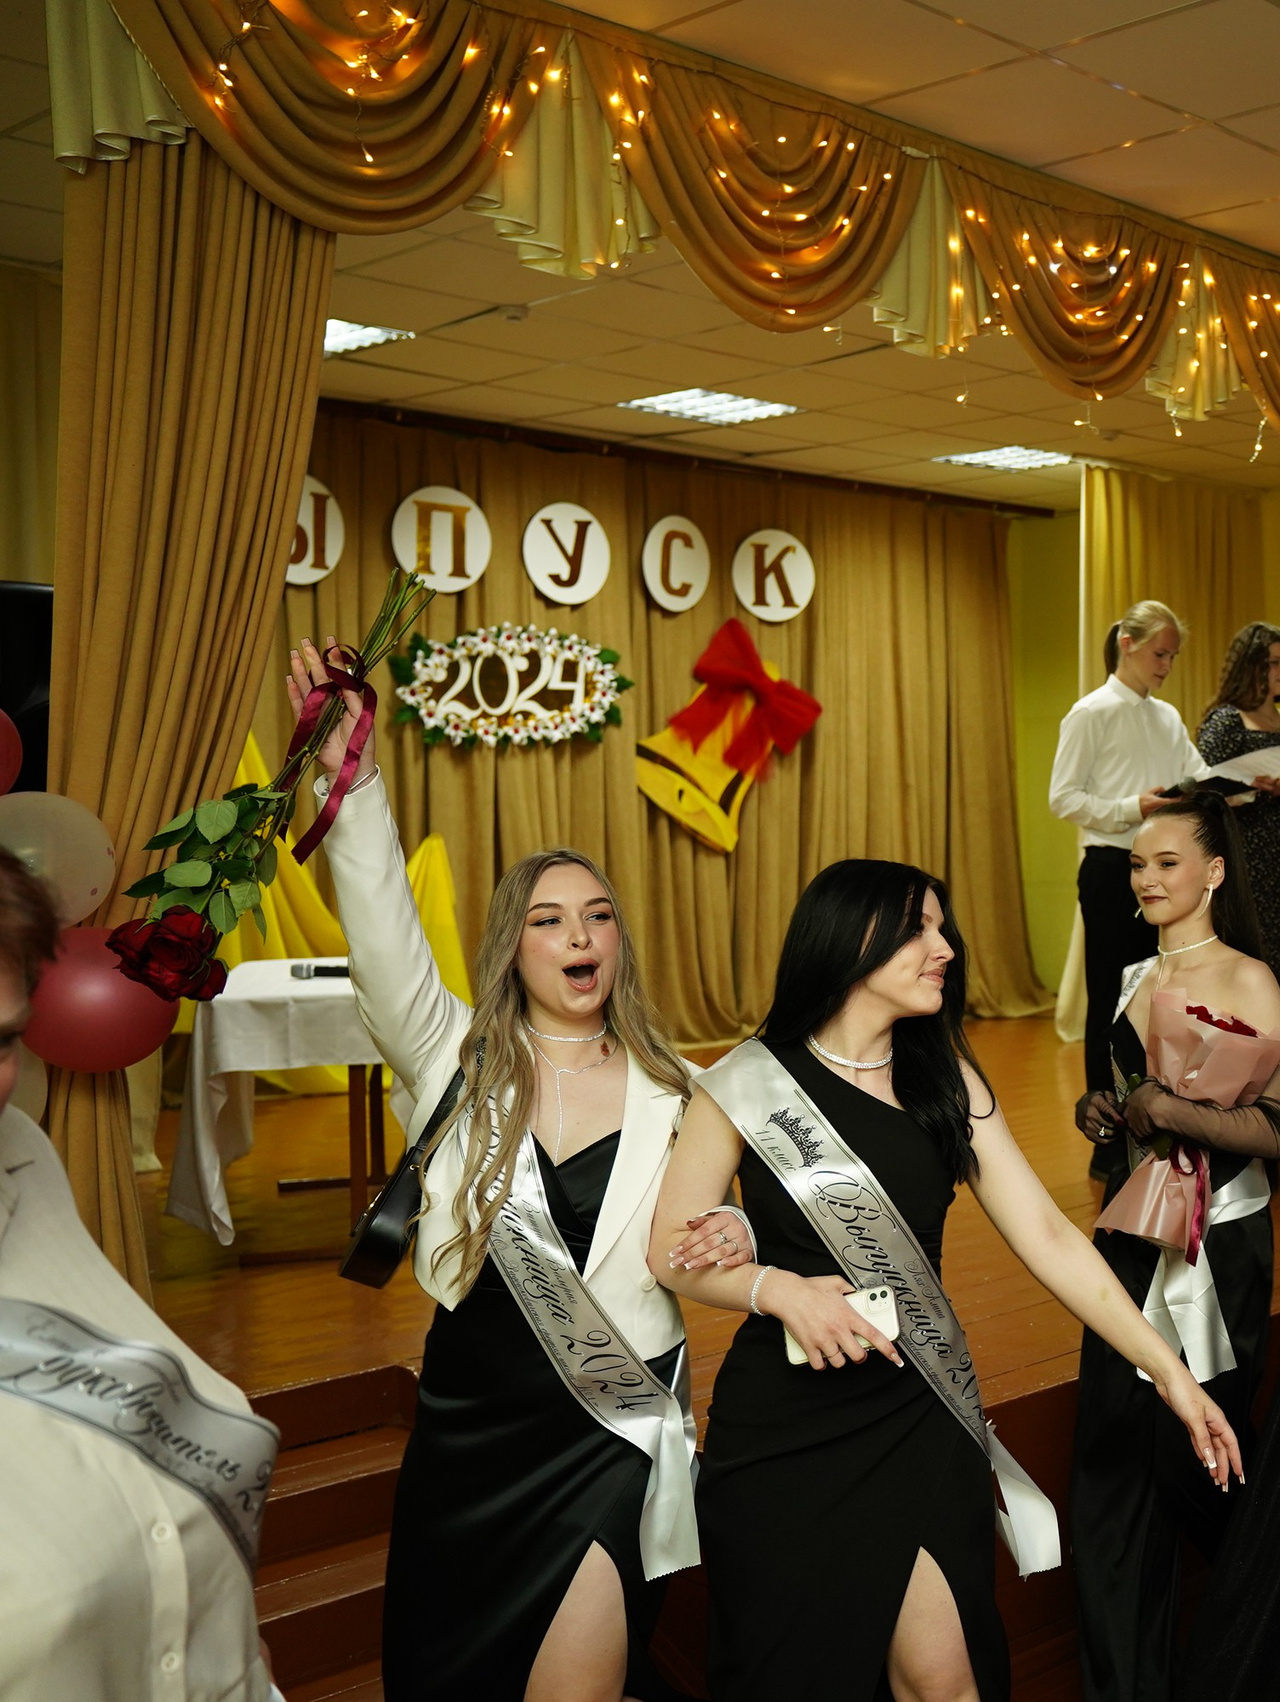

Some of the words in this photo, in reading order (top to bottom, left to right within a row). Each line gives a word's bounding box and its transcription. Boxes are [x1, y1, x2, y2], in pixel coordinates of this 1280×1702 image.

[289, 491, 799, 608] ЫПУСК
[432, 649, 586, 719] 2024
[767, 1146, 797, 1172] класс
[807, 1170, 953, 1359] Выпускница
[560, 1330, 661, 1411] 2024
